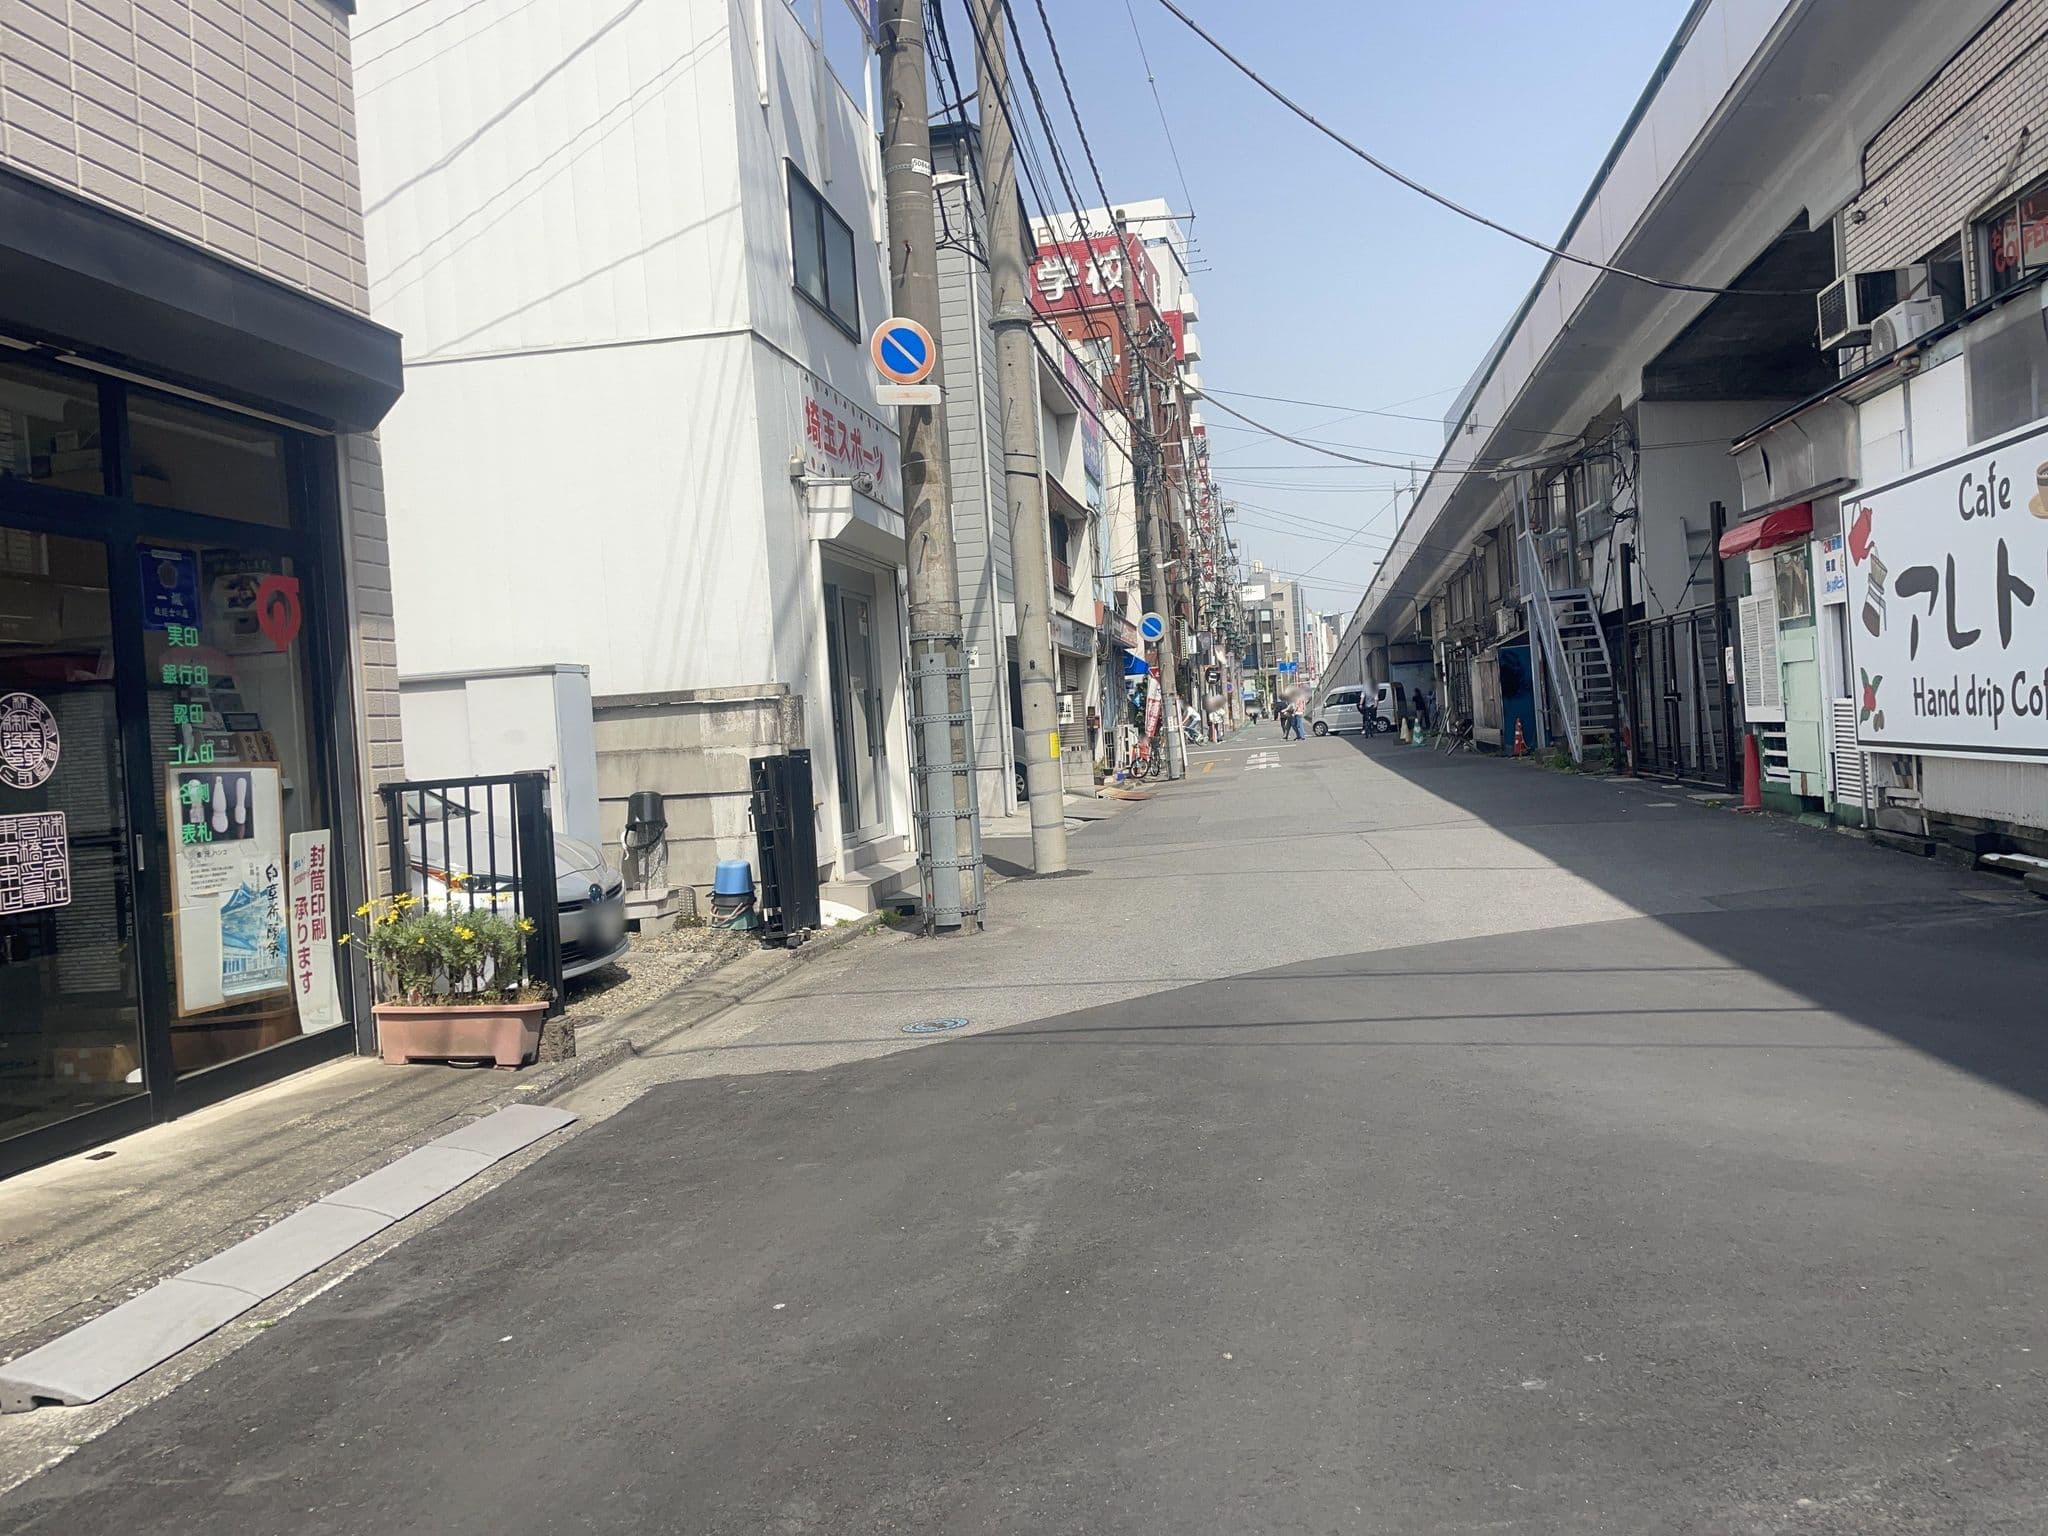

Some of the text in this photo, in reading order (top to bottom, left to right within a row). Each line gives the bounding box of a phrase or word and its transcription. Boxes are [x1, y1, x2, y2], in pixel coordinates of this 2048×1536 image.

[1028, 245, 1126, 301] 学校
[805, 396, 883, 482] 埼玉スポーツ
[1958, 460, 2011, 520] Cafe
[1894, 537, 2048, 662] アレト
[167, 625, 199, 647] 実印
[161, 663, 208, 685] 銀行印
[1913, 674, 1960, 717] Hand
[1966, 673, 2004, 731] drip
[173, 703, 204, 724] 認印
[168, 743, 214, 765] ゴム印
[179, 782, 210, 804] 名刺
[181, 823, 212, 844] 表札
[310, 844, 327, 942] 封筒印刷
[294, 896, 314, 994] 承ります
